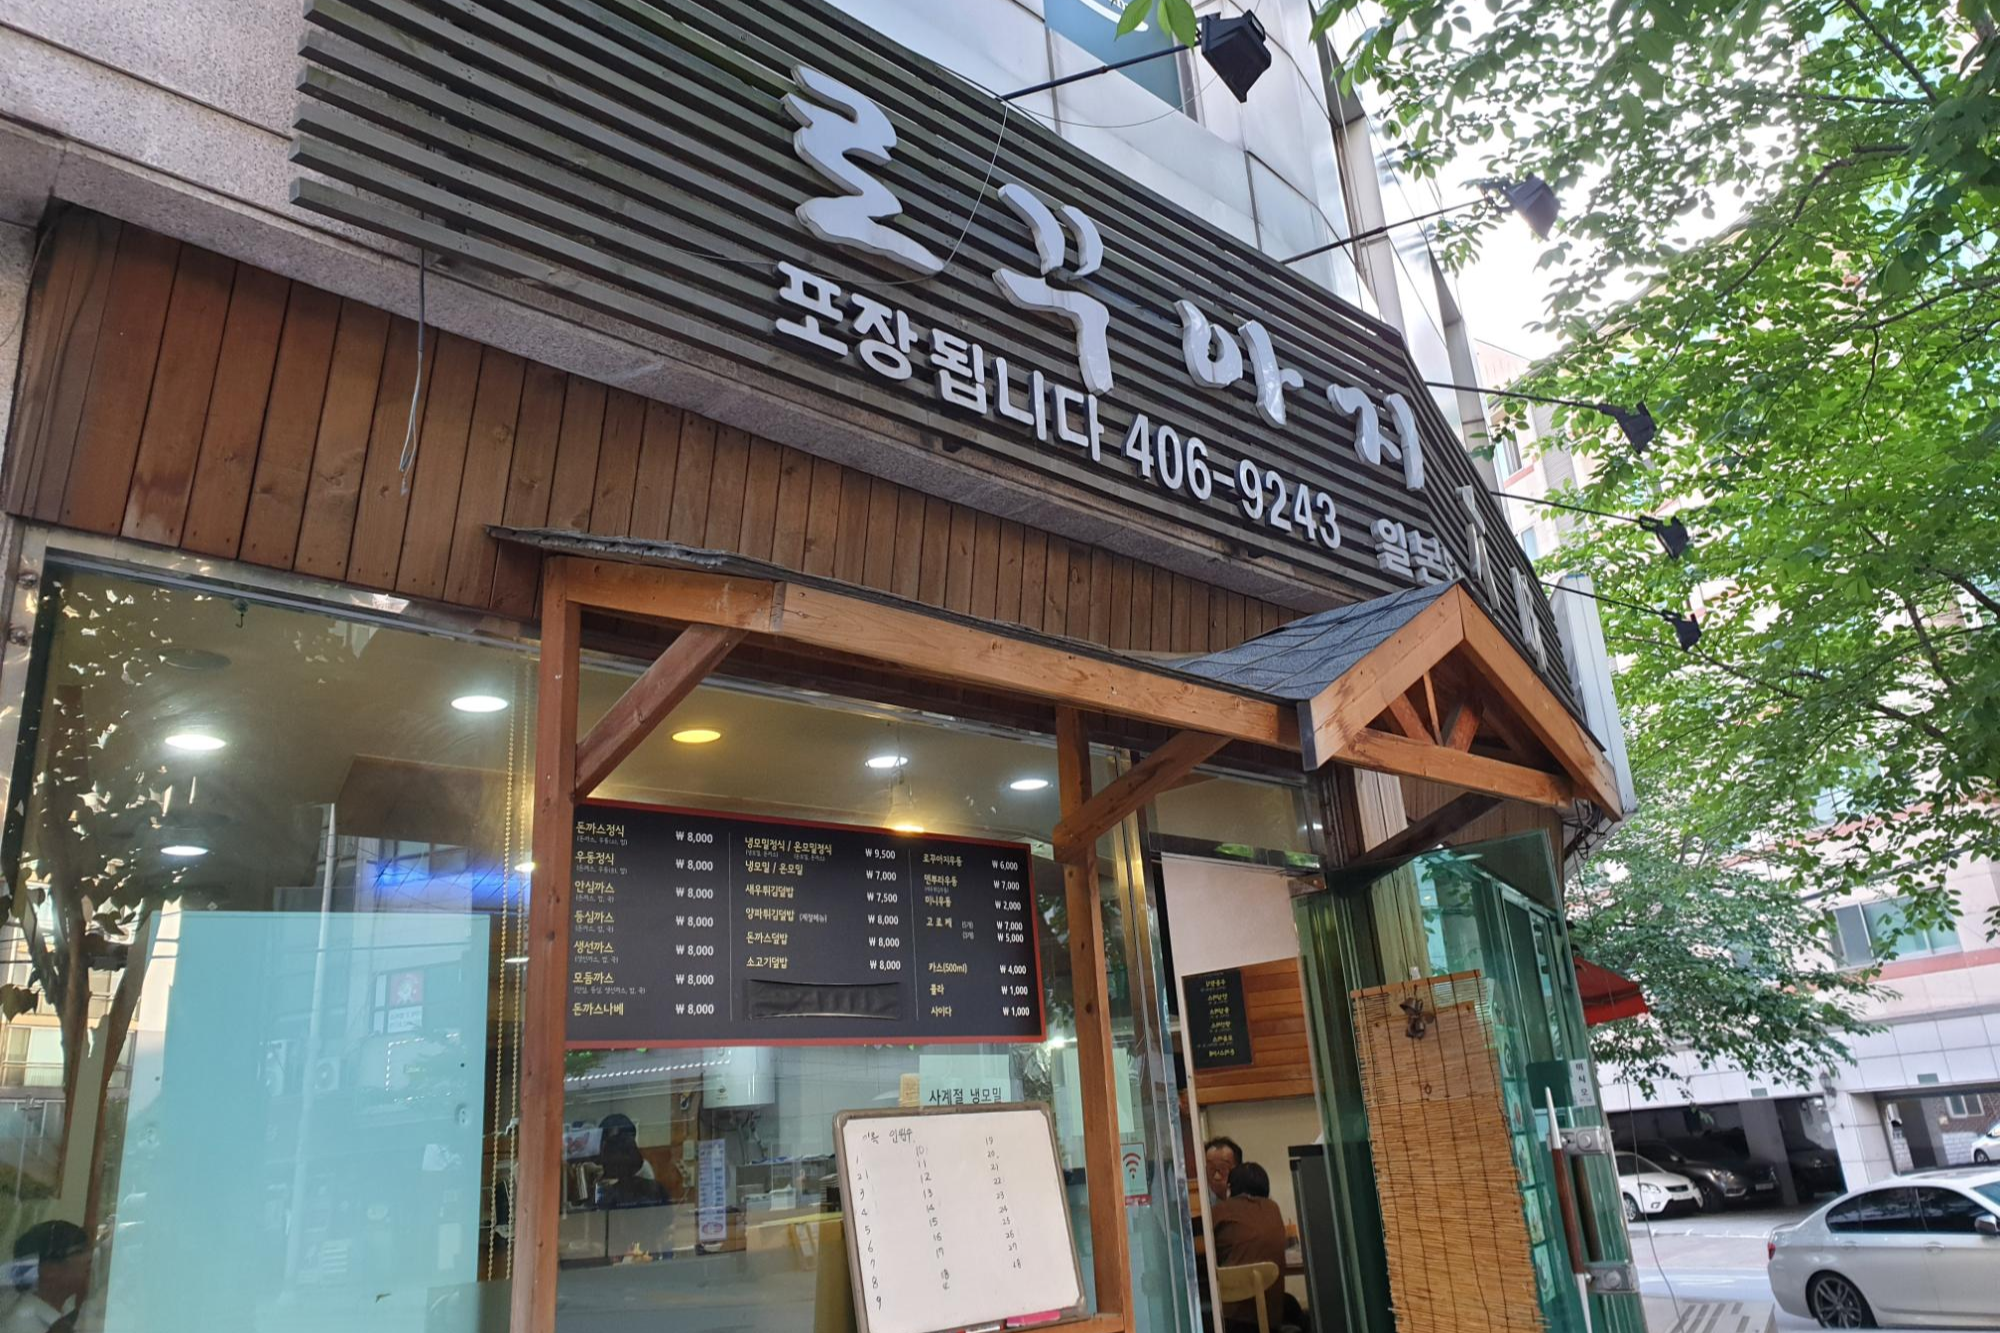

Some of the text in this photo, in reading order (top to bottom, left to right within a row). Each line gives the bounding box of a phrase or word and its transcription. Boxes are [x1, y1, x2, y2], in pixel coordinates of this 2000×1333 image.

[774, 260, 1104, 463] 포장됩니다
[1123, 414, 1342, 551] 406-9243
[576, 822, 625, 838] 돈까스정식
[686, 832, 713, 844] 8,000
[744, 836, 785, 853] 냉모밀정식
[793, 841, 832, 856] 온모밀정식
[575, 850, 615, 866] 우동정식
[874, 848, 896, 860] 9,500
[686, 860, 714, 872] 8,000
[745, 860, 770, 874] 냉모밀
[778, 863, 804, 876] 온모밀
[1000, 860, 1018, 871] 6,000
[875, 871, 896, 882] 7,000
[574, 880, 615, 894] 안심까스
[1002, 880, 1020, 890] 7,000
[686, 888, 714, 900] 8,000
[745, 884, 794, 899] 새우튀김덮밥
[876, 893, 898, 904] 7,500
[924, 895, 952, 908] 미니우동
[1003, 901, 1022, 911] 2,000
[574, 910, 614, 924] 등심까스
[746, 908, 795, 922] 양파튀김덮밥
[877, 914, 899, 926] 8,000
[686, 916, 714, 928] 8,000
[1004, 921, 1024, 932] 7,000
[746, 932, 788, 946] 돈까스덮밥
[878, 938, 900, 948] 8,000
[1006, 933, 1024, 944] 5,000
[573, 940, 614, 954] 생선까스
[686, 945, 714, 957] 8,000
[746, 956, 788, 970] 소고기덮밥
[879, 960, 901, 972] 8,000
[928, 962, 968, 975] 카스(500ml)
[1008, 965, 1027, 975] 4,000
[572, 972, 614, 986] 모듬까스
[686, 974, 714, 986] 8,000
[1010, 986, 1028, 996] 1,000
[572, 1002, 624, 1017] 돈까스나베
[687, 1004, 715, 1016] 8,000
[930, 1005, 952, 1018] 사이다
[1012, 1006, 1030, 1018] 1,000
[929, 1088, 964, 1106] 사계절
[970, 1087, 1002, 1104] 냉모밀
[920, 1172, 932, 1184] 12
[860, 1188, 865, 1200] 3
[923, 1188, 934, 1200] 13
[928, 1217, 938, 1227] 15
[864, 1225, 871, 1235] 5
[933, 1232, 942, 1242] 16
[868, 1240, 874, 1253] 6
[872, 1276, 879, 1290] 8
[876, 1296, 882, 1311] 9
